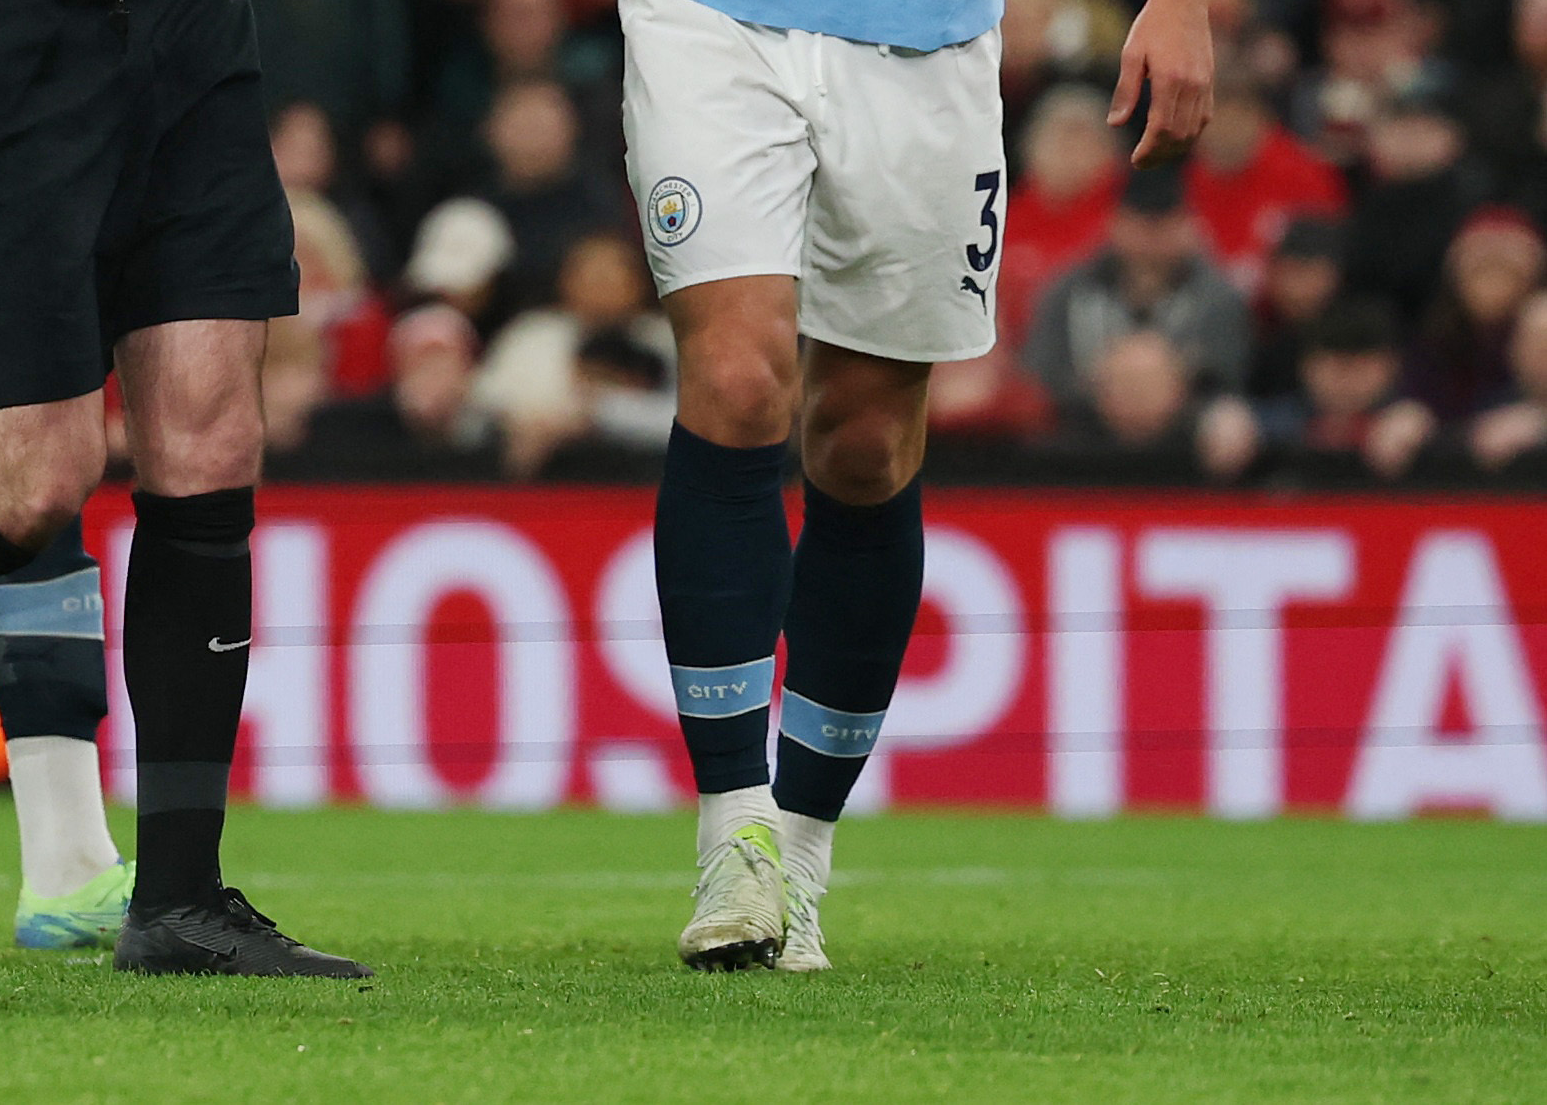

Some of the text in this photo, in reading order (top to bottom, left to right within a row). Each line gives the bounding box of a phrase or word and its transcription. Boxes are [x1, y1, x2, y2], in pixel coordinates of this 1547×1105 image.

[966, 170, 1001, 272] 3
[687, 680, 748, 700] CITY
[820, 724, 877, 740] CITY
